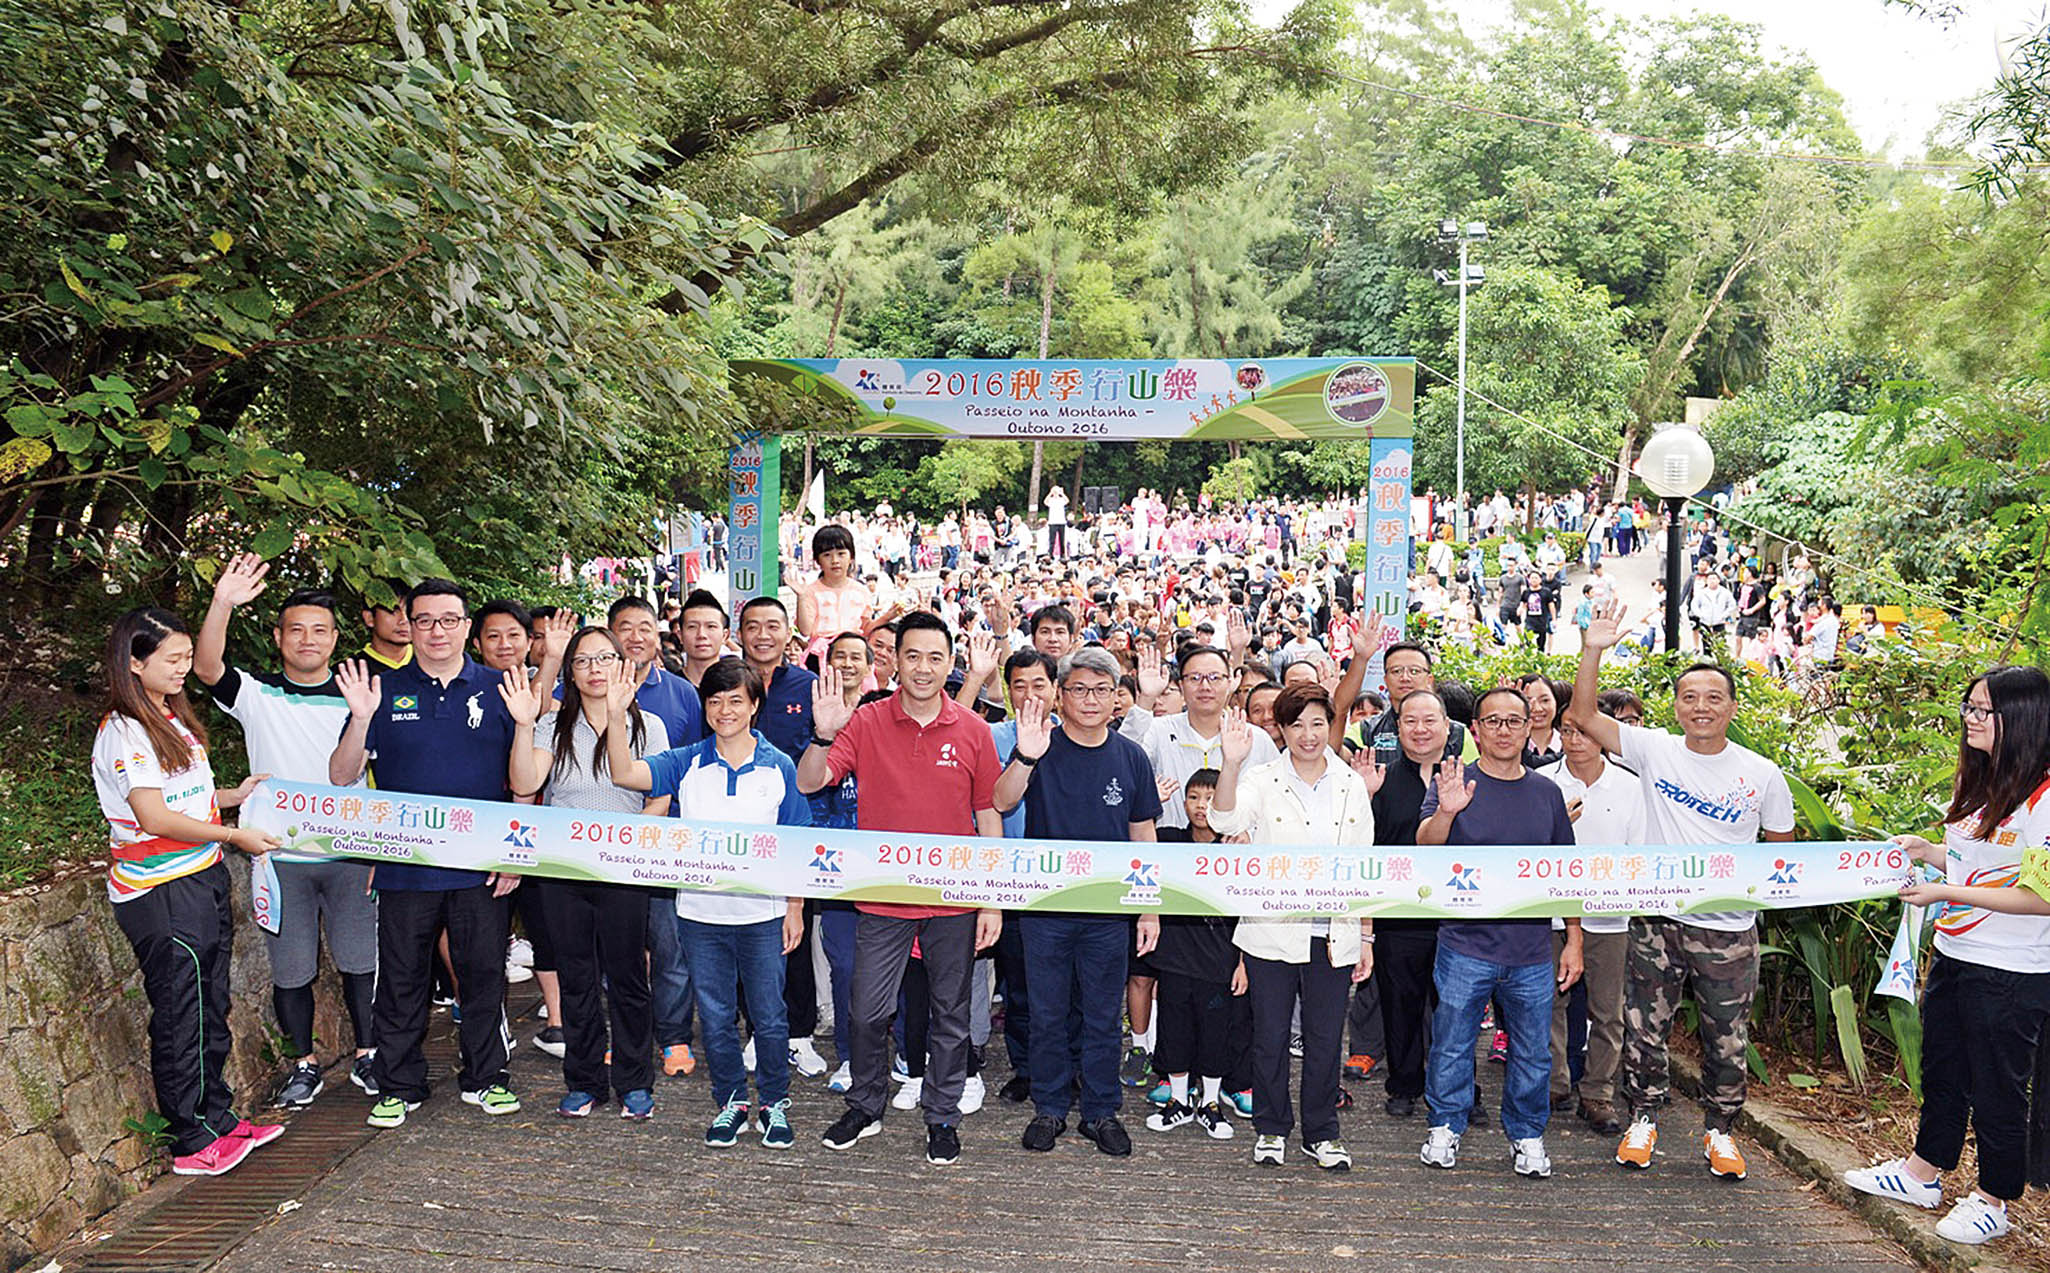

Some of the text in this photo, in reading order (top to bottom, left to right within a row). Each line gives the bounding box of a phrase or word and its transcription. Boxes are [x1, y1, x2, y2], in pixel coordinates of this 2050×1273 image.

[965, 404, 1022, 417] Passeio
[1029, 407, 1050, 417] na
[1057, 405, 1137, 418] Montanha
[1008, 422, 1109, 434] Outono 2016
[732, 455, 761, 467] 2016
[1374, 466, 1409, 478] 2016
[734, 471, 759, 619] 秋季行山
[392, 713, 420, 722] BRAZIL
[1654, 778, 1742, 823] PROTECH
[302, 821, 347, 837] Passeio
[352, 830, 367, 840] na
[374, 830, 434, 847] Montanha
[332, 839, 412, 858] Outono 2016
[598, 851, 645, 866] Passeio
[651, 859, 667, 868] na
[675, 858, 736, 873] Montanha
[632, 867, 713, 885] Outono 2016
[907, 873, 957, 887] Passeio
[961, 879, 978, 888] na
[985, 878, 1050, 891] Montanha
[943, 889, 1027, 904] Outono 2016
[1225, 885, 1275, 897] Passeio
[1281, 888, 1298, 897] na
[1305, 886, 1370, 898] Montanha
[1548, 886, 1598, 898] Passeio
[1602, 889, 1620, 897] na
[1627, 884, 1691, 896] Montanha
[1262, 900, 1347, 912] Outono 2016
[1584, 899, 1669, 912] Outono 2016
